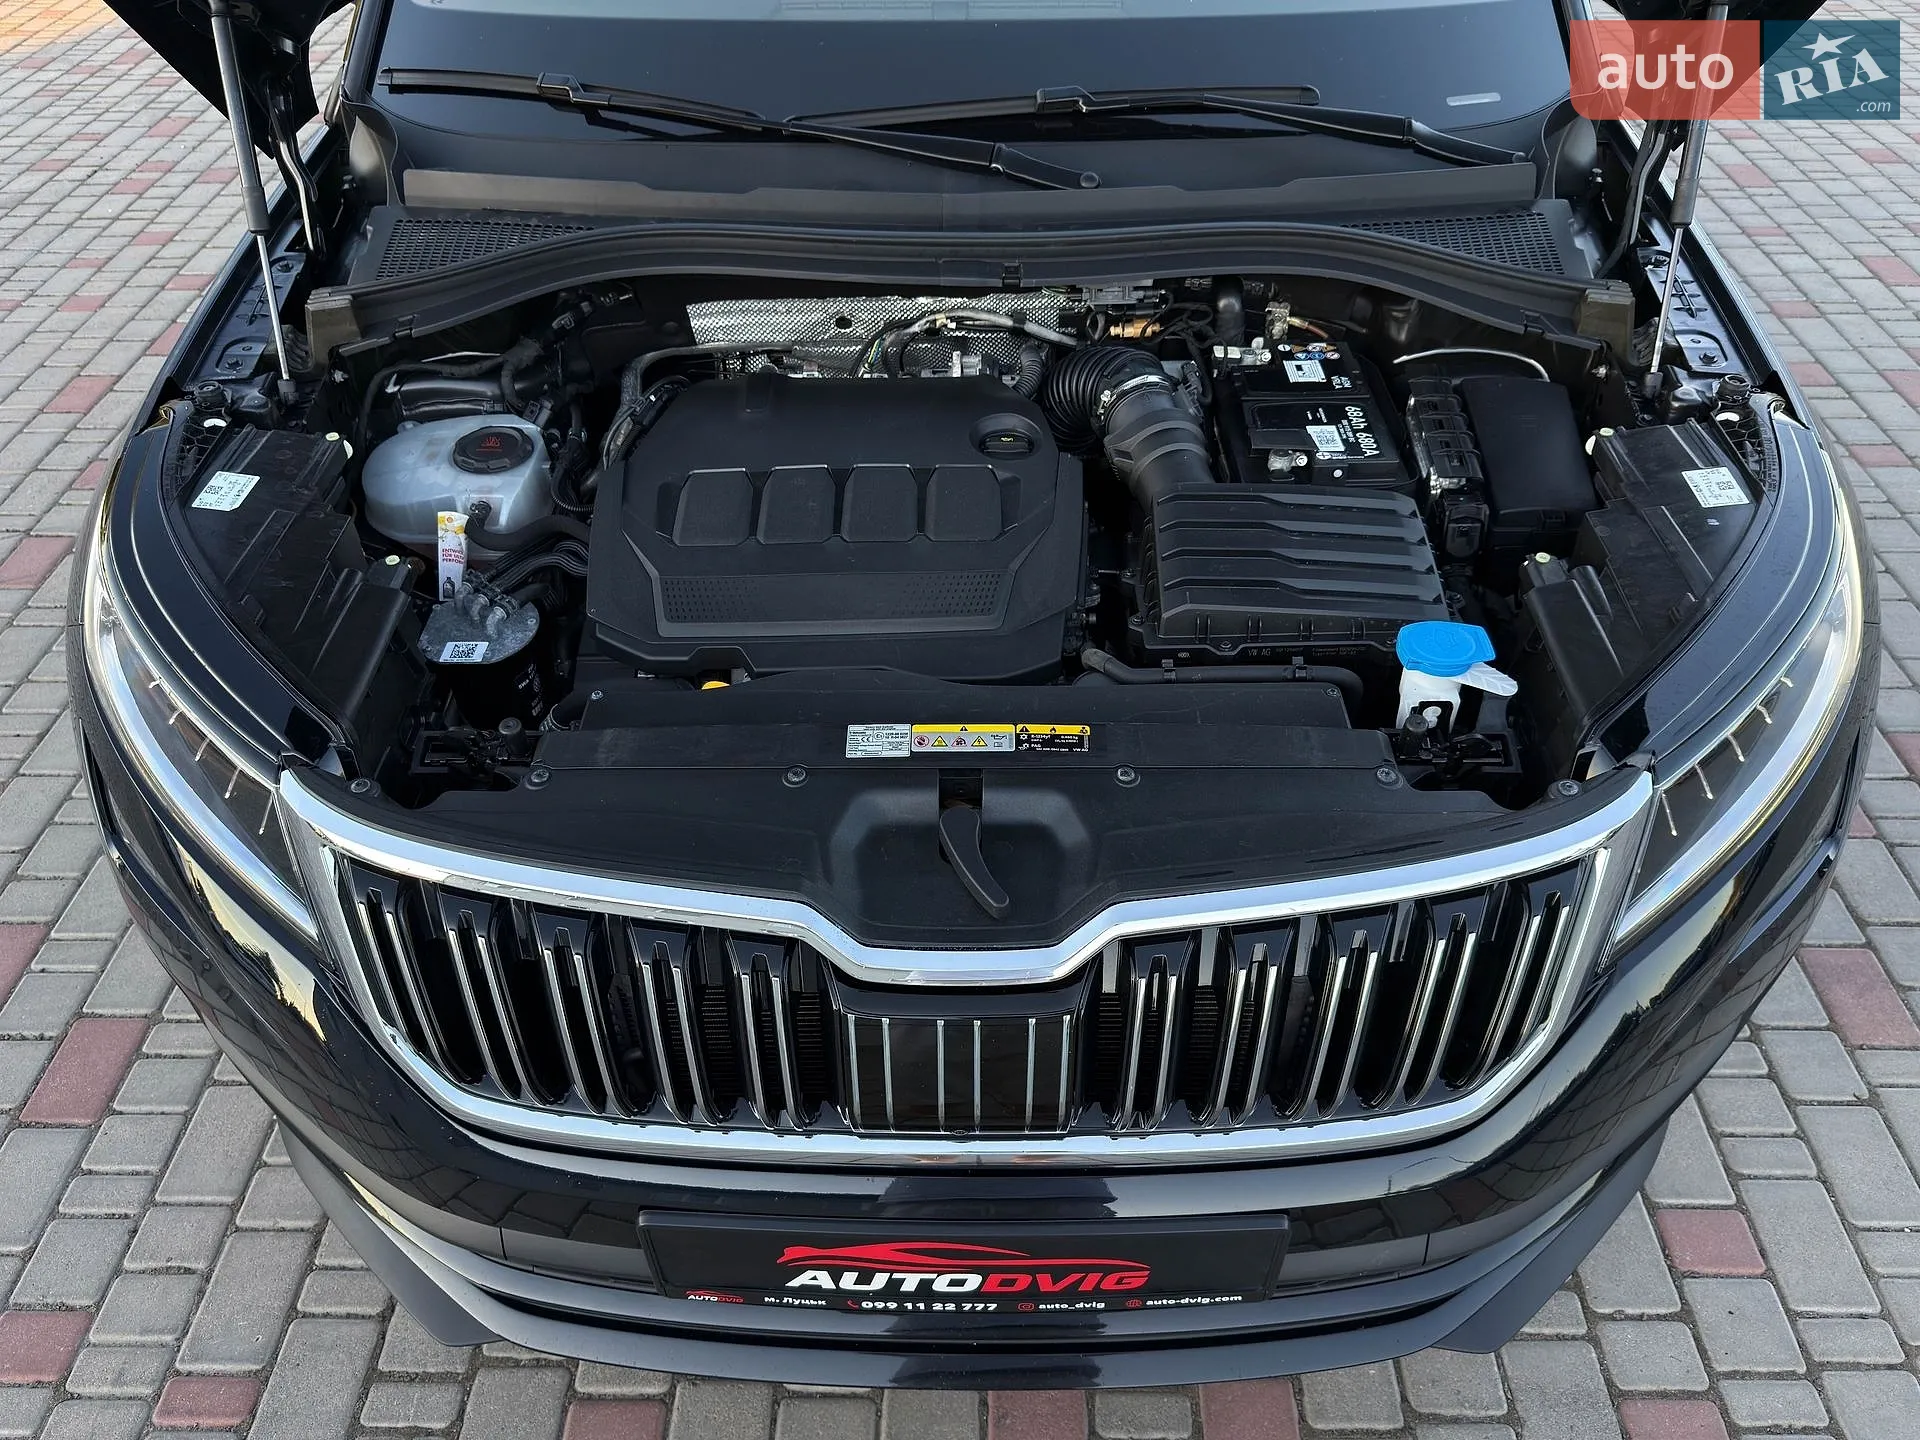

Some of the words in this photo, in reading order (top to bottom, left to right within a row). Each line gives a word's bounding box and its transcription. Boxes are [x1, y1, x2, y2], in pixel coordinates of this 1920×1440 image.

[1345, 406, 1368, 430] 68Ah
[1356, 432, 1380, 457] 680A
[785, 1270, 1150, 1293] AUTODVIG
[688, 1294, 744, 1303] AUTODVIG
[782, 1297, 827, 1306] Луцьк
[1146, 1296, 1243, 1306] auto-dvig.com
[861, 1301, 898, 1309] 099
[903, 1302, 925, 1310] 11
[932, 1302, 957, 1311] 22
[961, 1303, 998, 1311] 777
[1038, 1301, 1105, 1310] auto_dvig
